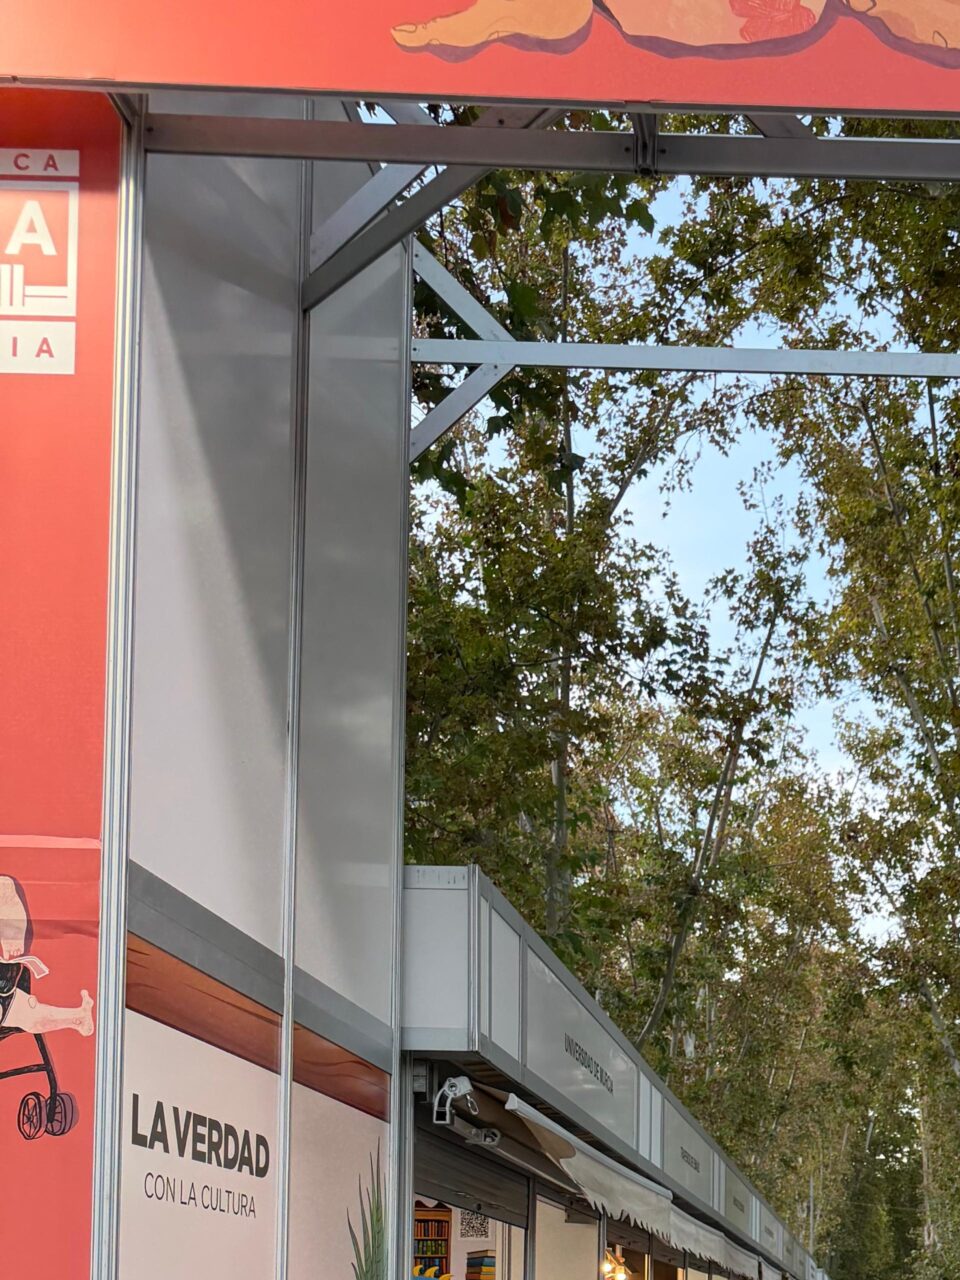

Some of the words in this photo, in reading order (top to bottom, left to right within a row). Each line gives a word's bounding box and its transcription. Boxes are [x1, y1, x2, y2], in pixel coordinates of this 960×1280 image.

[5, 200, 57, 256] A
[131, 1093, 169, 1153] LA
[172, 1105, 270, 1178] VERDAD
[144, 1172, 176, 1203] CON
[180, 1180, 197, 1207] LA
[202, 1185, 256, 1219] CULTURA
